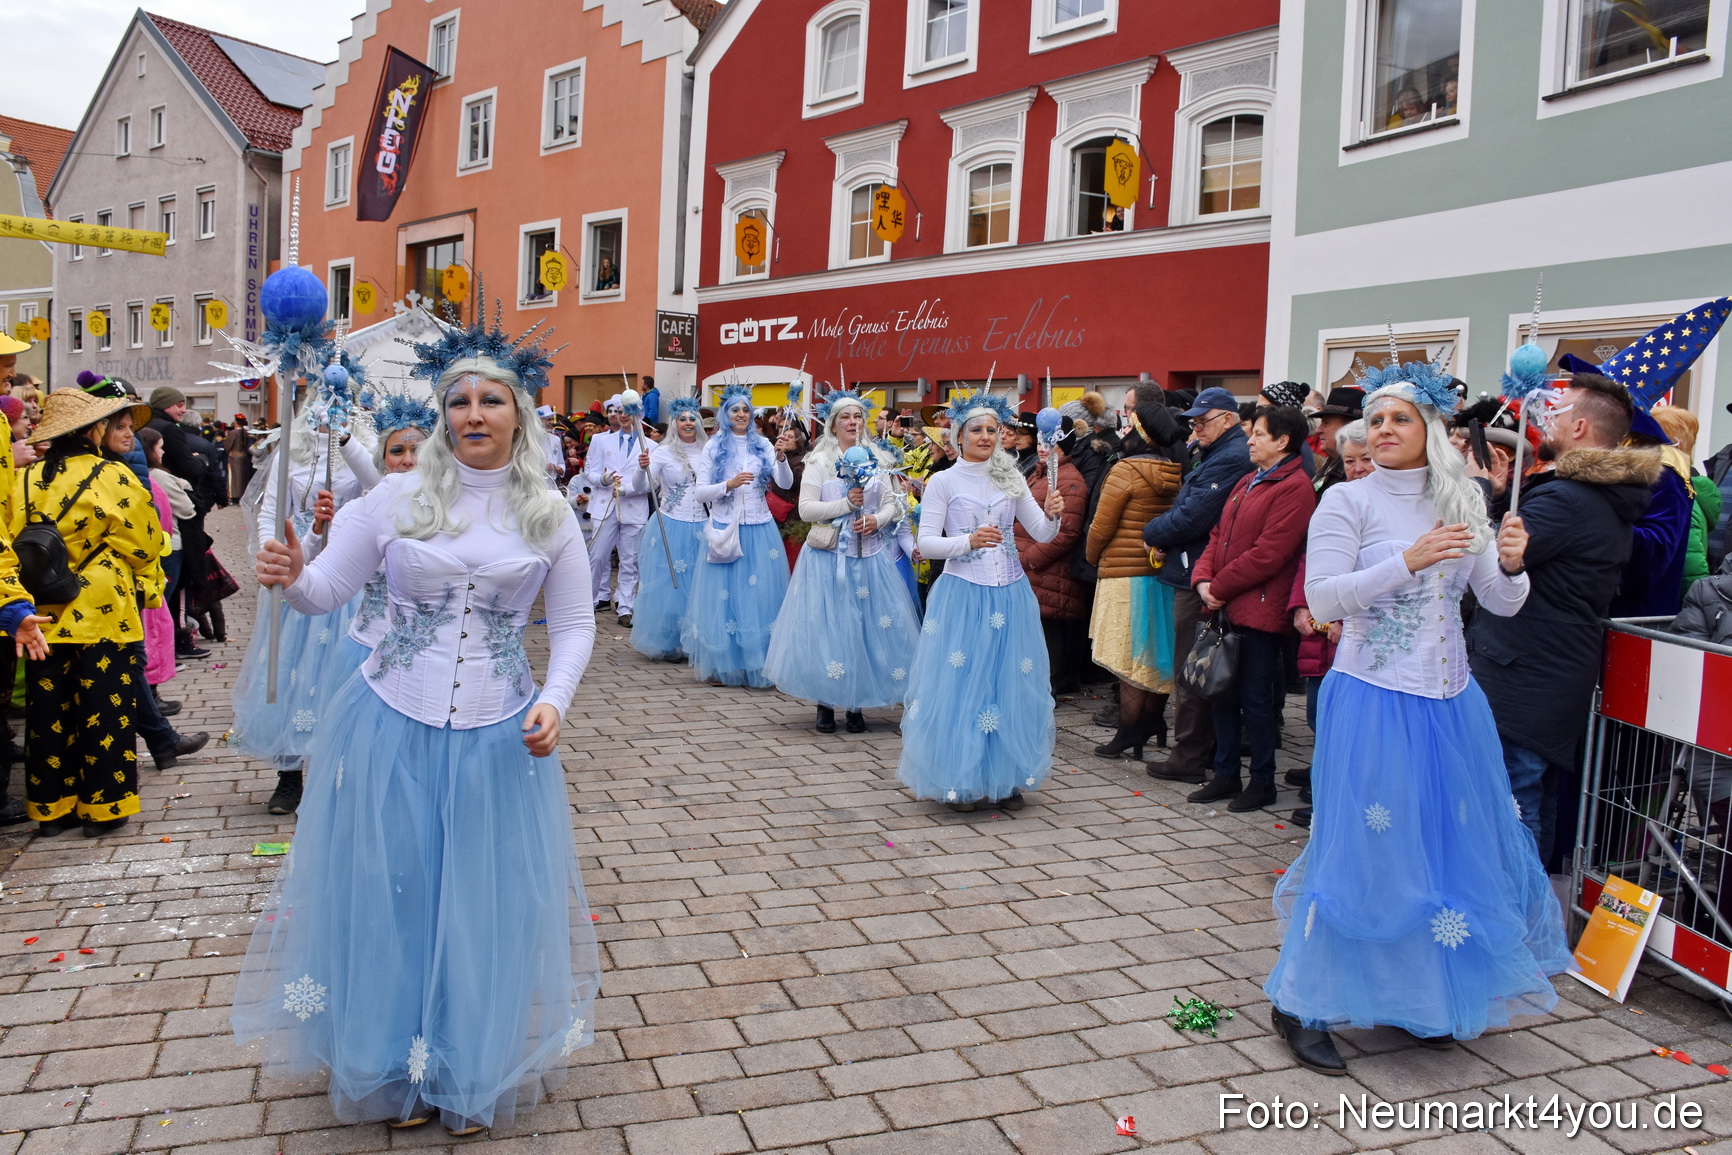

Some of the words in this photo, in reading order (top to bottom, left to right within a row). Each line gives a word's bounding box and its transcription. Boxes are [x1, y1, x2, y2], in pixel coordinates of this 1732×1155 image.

[248, 205, 259, 270] UHREN
[245, 278, 258, 367] SCHMU
[661, 318, 692, 336] CAFÉ
[720, 315, 804, 345] GÖTZ.
[806, 307, 848, 341] Mode
[847, 314, 889, 345] Genuss
[894, 298, 950, 332] Erlebnis
[825, 309, 896, 361] Mode
[895, 329, 972, 373] Genuss
[982, 295, 1087, 352] Erlebnis
[135, 356, 174, 382] OEXL
